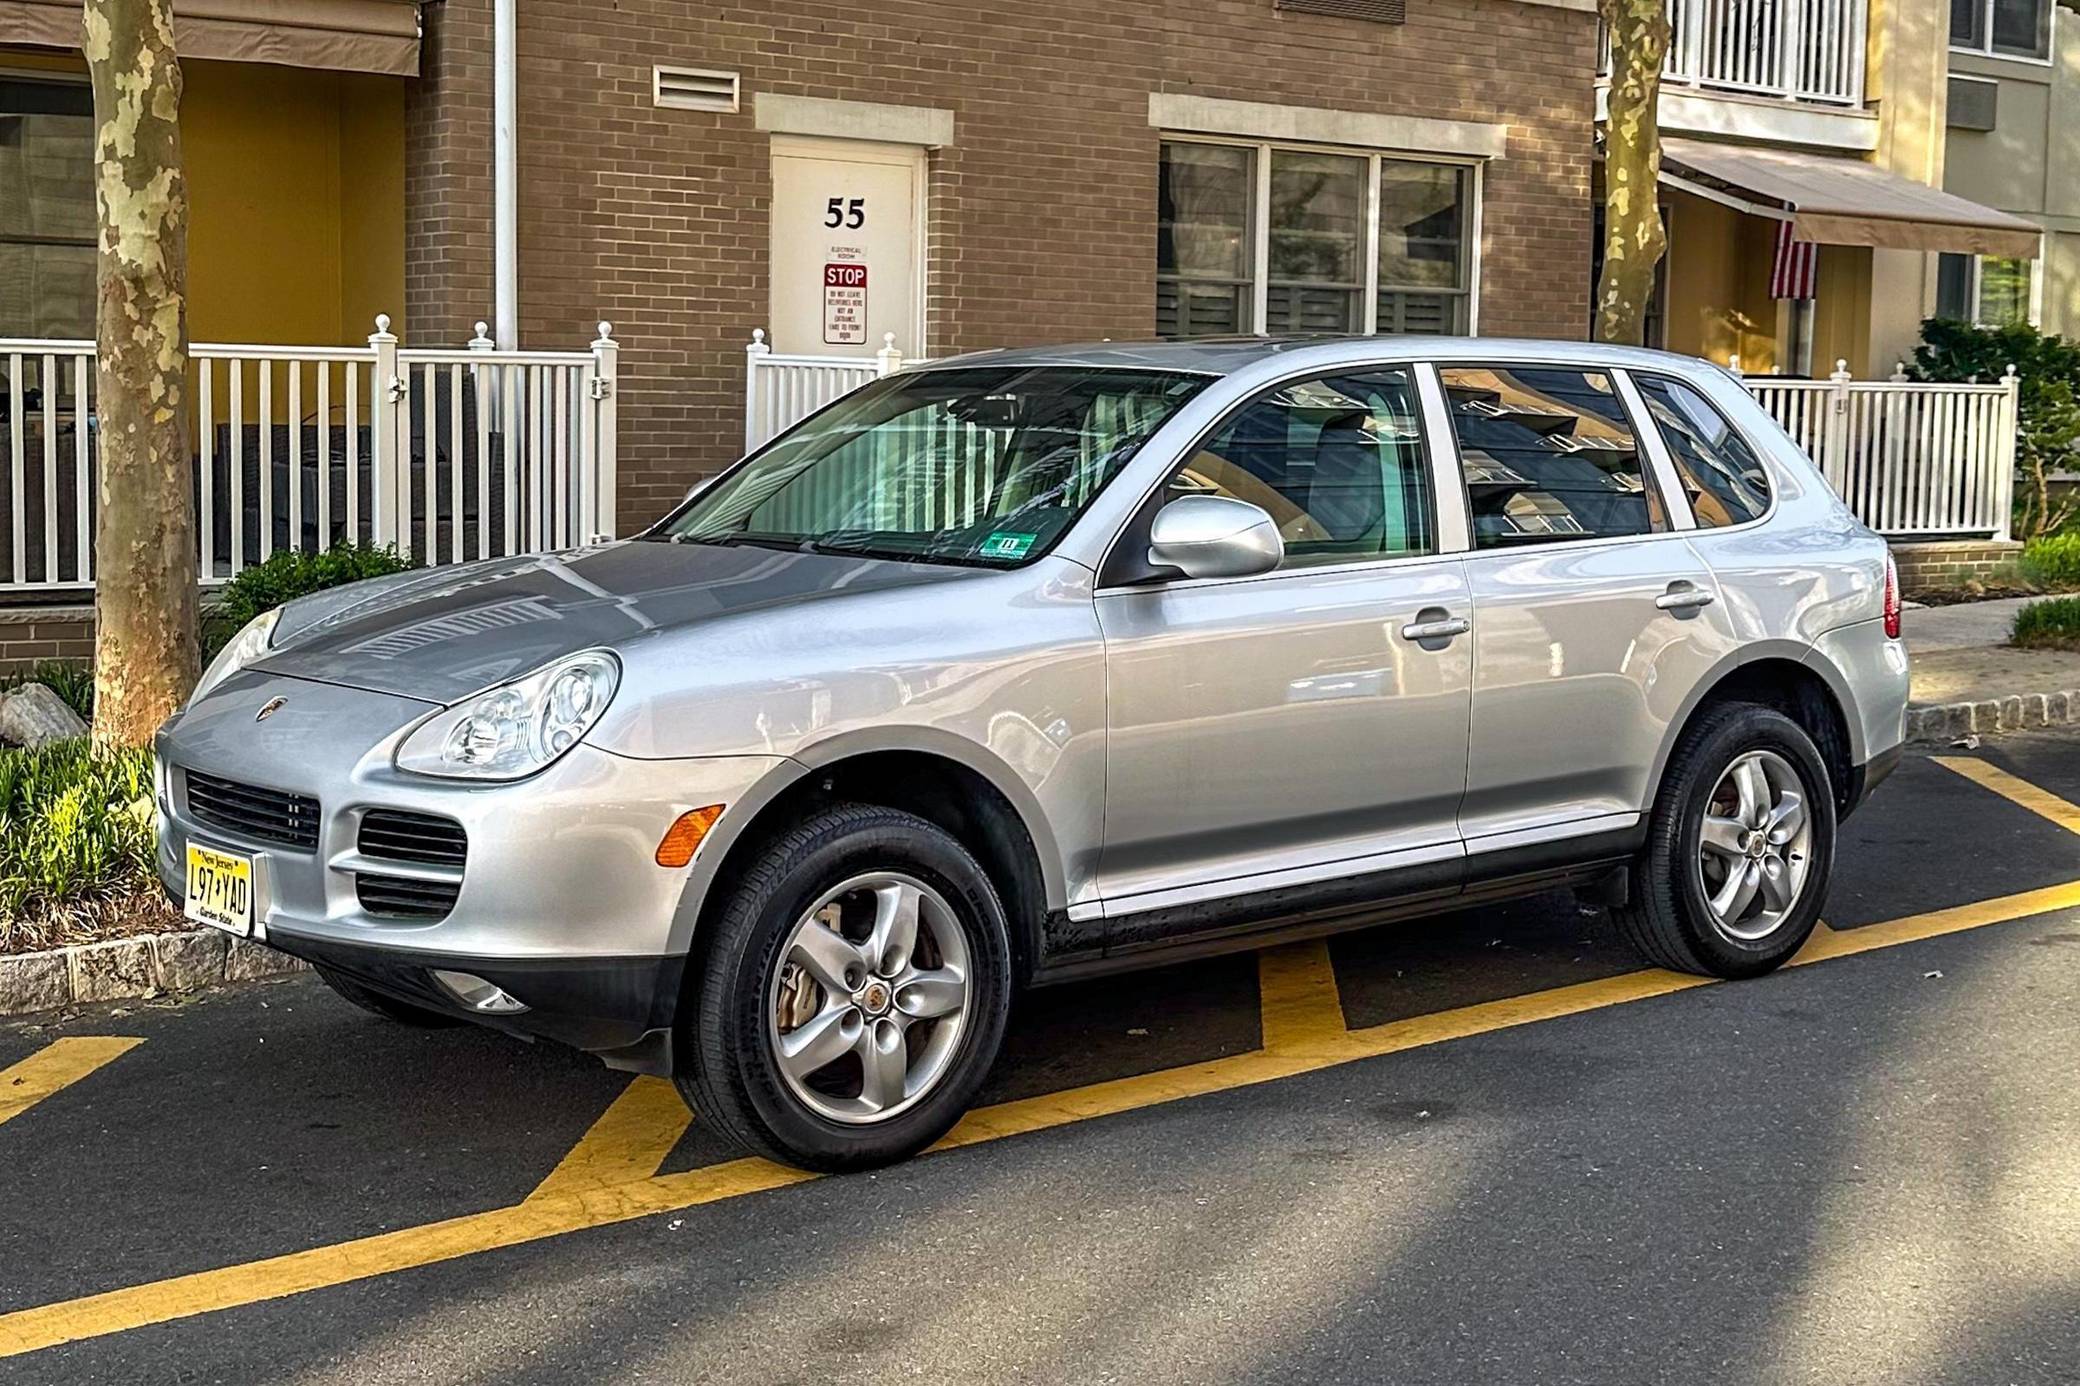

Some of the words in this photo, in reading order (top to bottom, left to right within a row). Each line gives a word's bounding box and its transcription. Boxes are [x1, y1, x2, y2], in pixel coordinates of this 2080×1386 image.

[824, 197, 865, 229] 55
[827, 268, 864, 285] STOP
[201, 850, 215, 864] New
[214, 855, 234, 871] Jersey
[190, 863, 214, 905] L97
[222, 873, 246, 916] YAD
[199, 906, 218, 920] Garden
[218, 912, 232, 925] State
